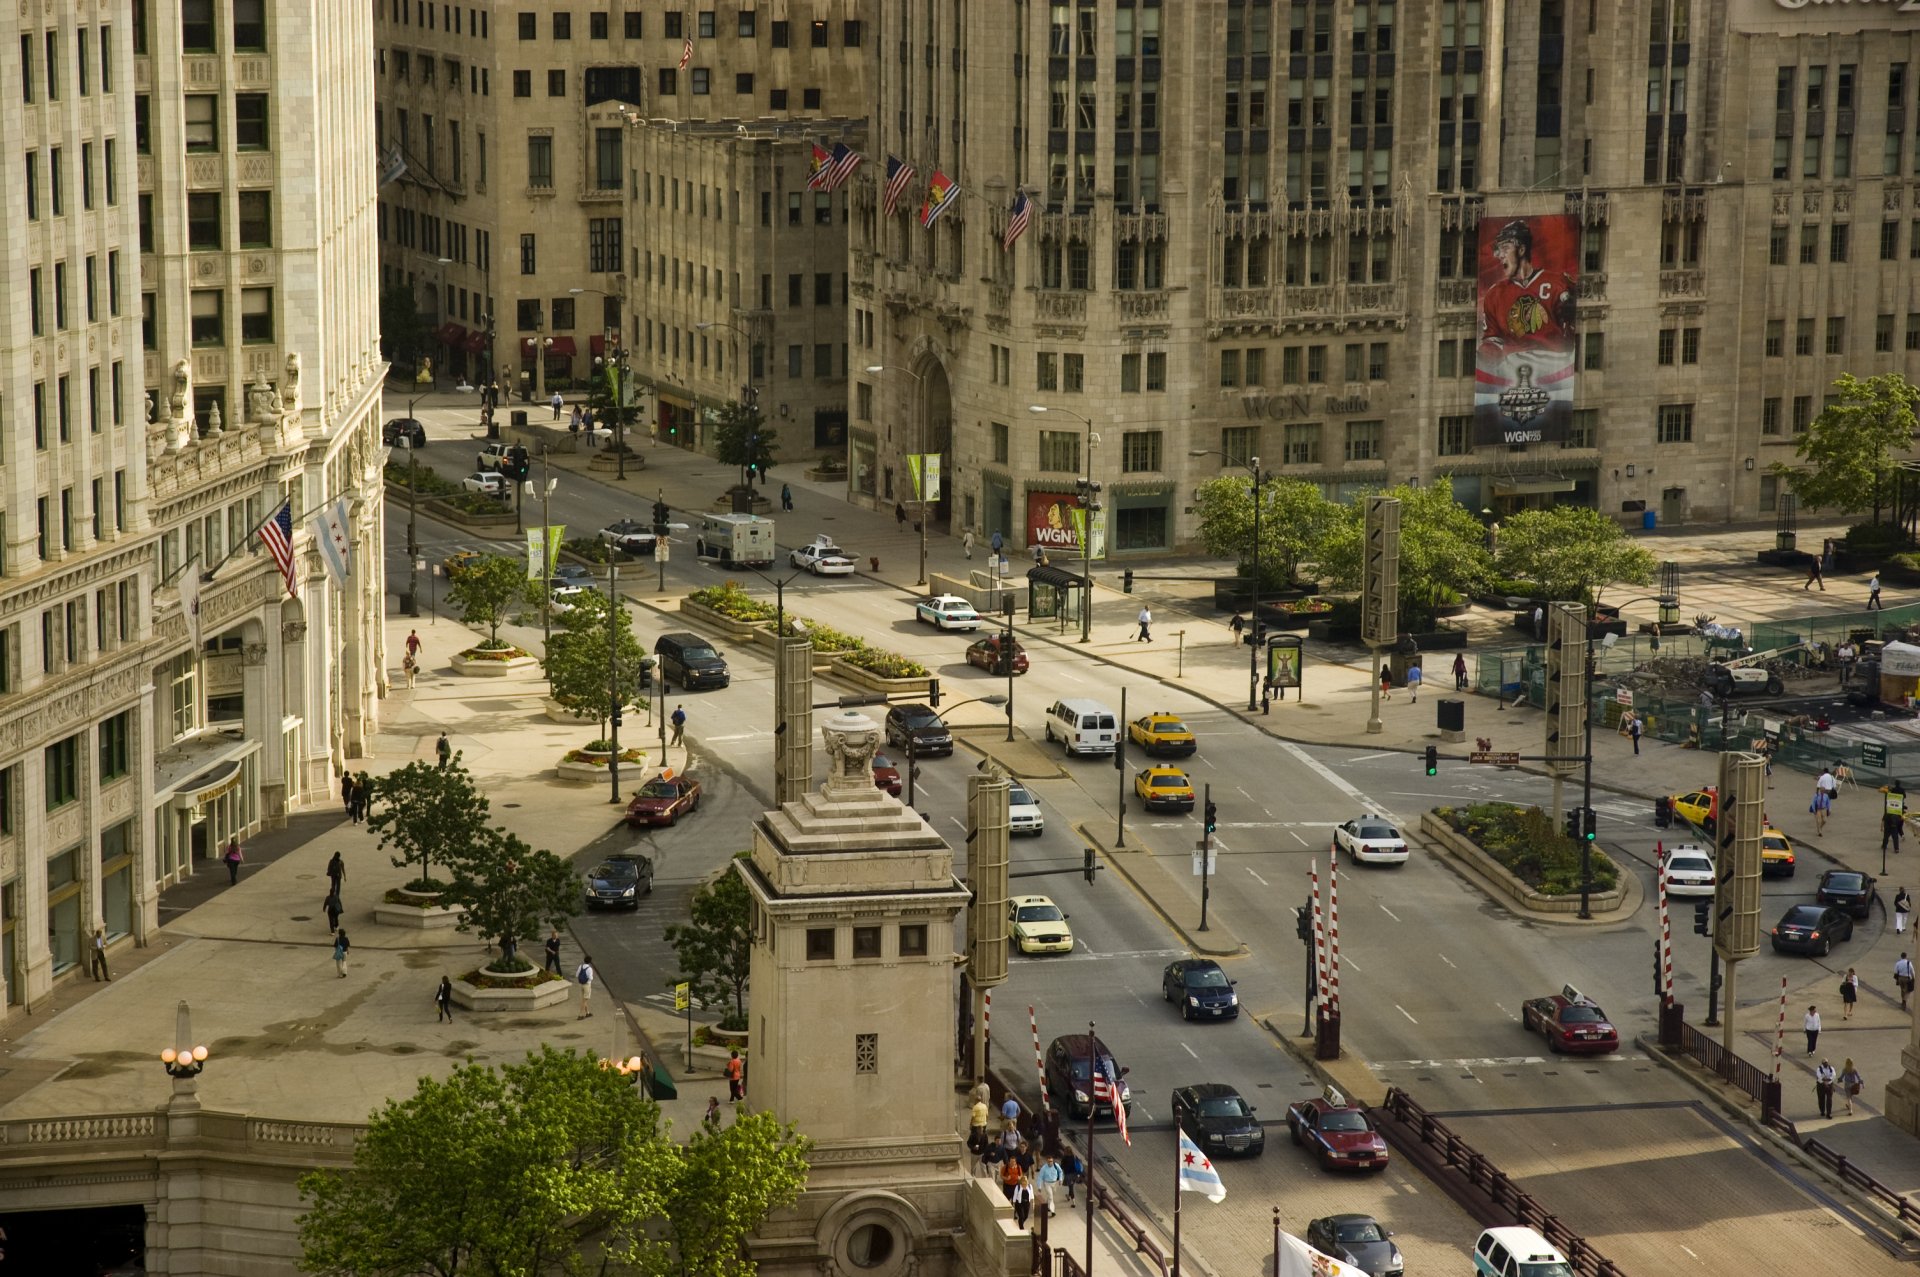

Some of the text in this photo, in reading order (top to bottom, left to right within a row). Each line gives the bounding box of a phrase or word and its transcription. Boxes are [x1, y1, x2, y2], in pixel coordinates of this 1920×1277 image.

[1539, 283, 1551, 299] C
[1501, 392, 1549, 404] FINAL
[1241, 394, 1369, 420] WGN Radio
[1504, 431, 1529, 442] WGN
[1036, 527, 1072, 543] WGN
[1740, 654, 1766, 665] TEREX
[820, 863, 858, 873] BEGUN
